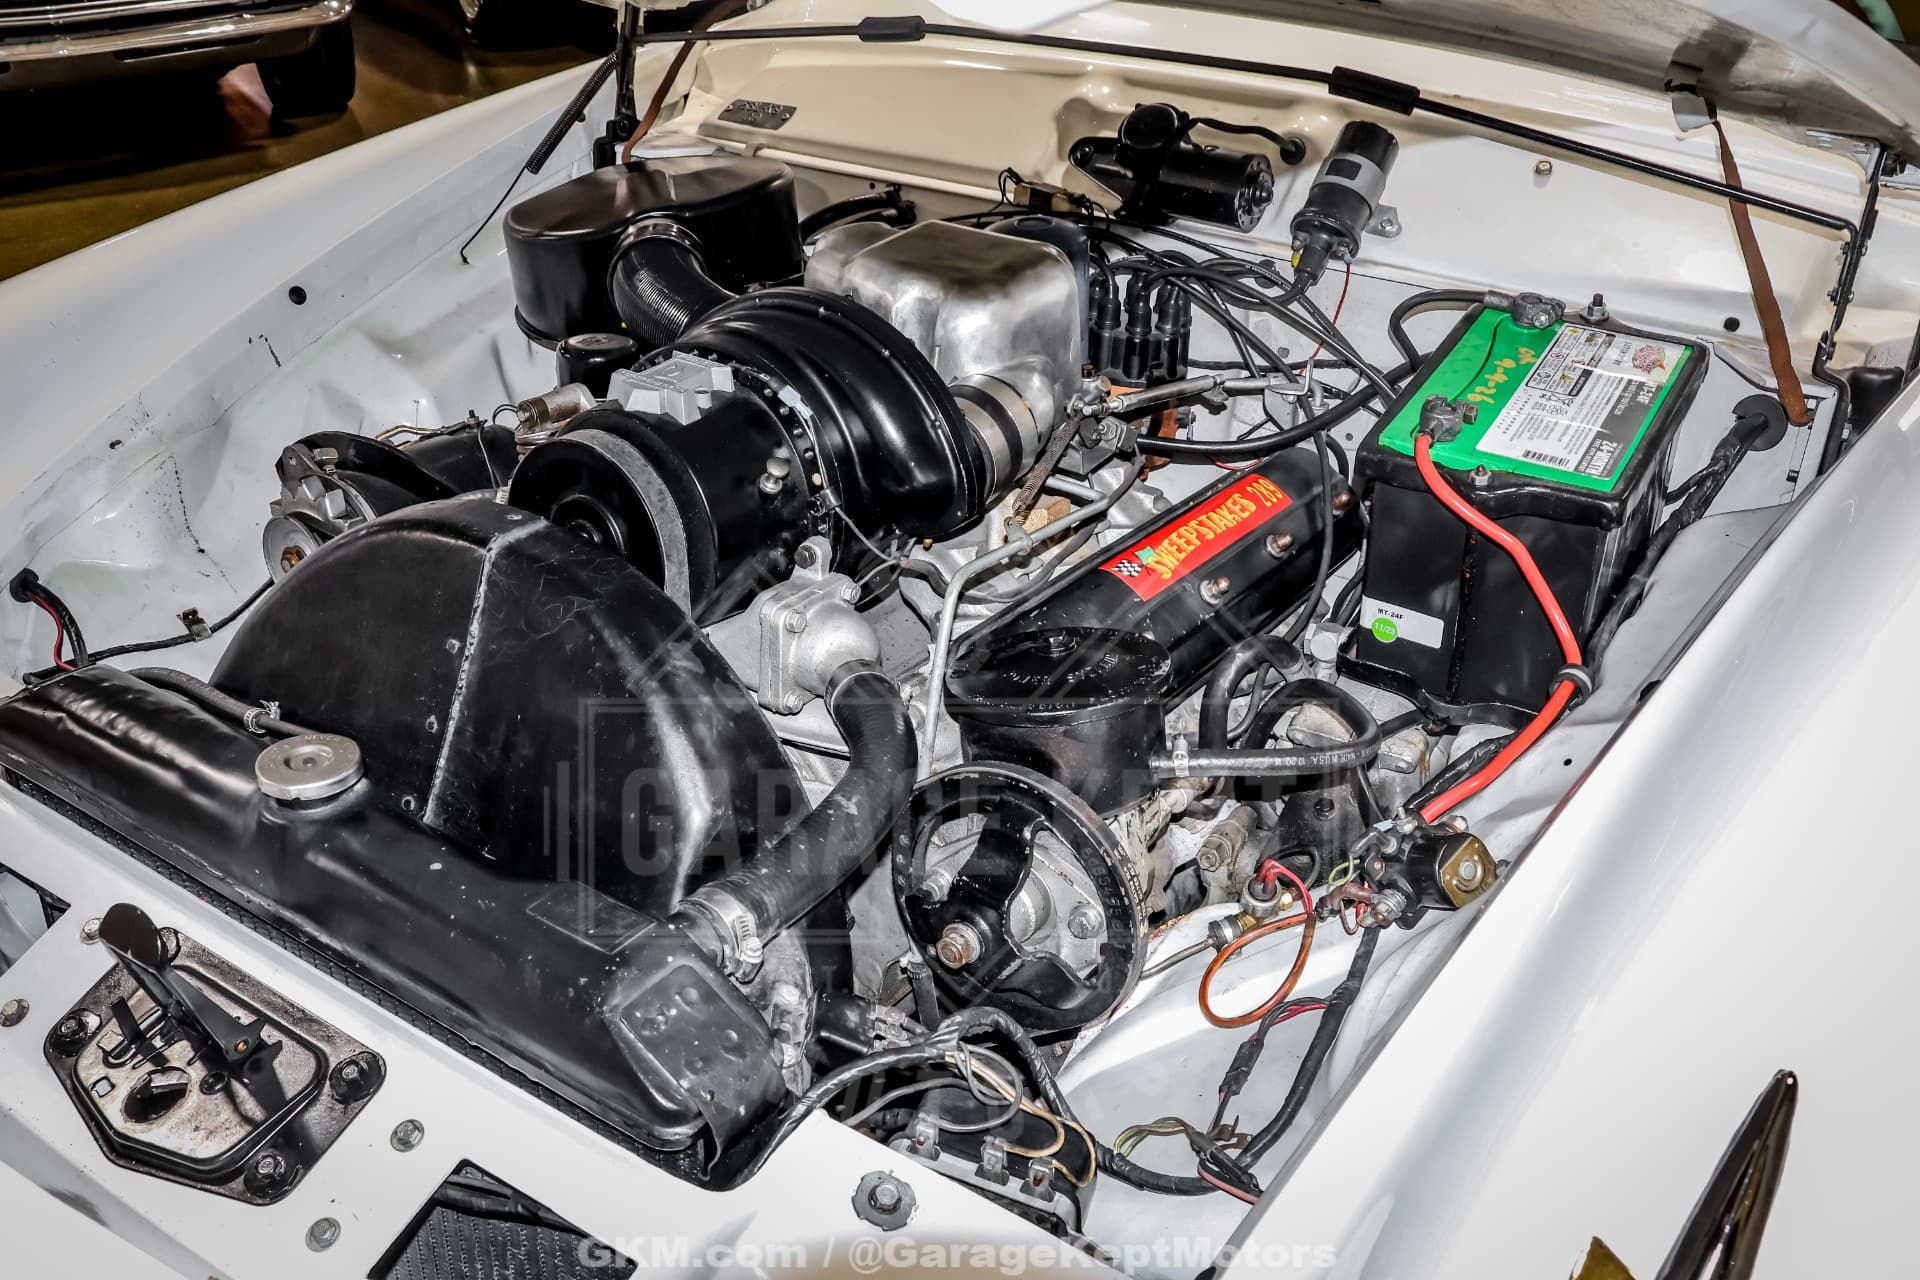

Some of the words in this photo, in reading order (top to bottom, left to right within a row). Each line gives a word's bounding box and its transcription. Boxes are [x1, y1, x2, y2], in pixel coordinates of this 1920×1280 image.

[1585, 440, 1618, 475] 24-MONTH
[1147, 493, 1257, 580] SWEEPSTAKES
[1247, 478, 1284, 508] 289
[1377, 608, 1405, 620] MT-24F
[1374, 622, 1396, 636] 11/23
